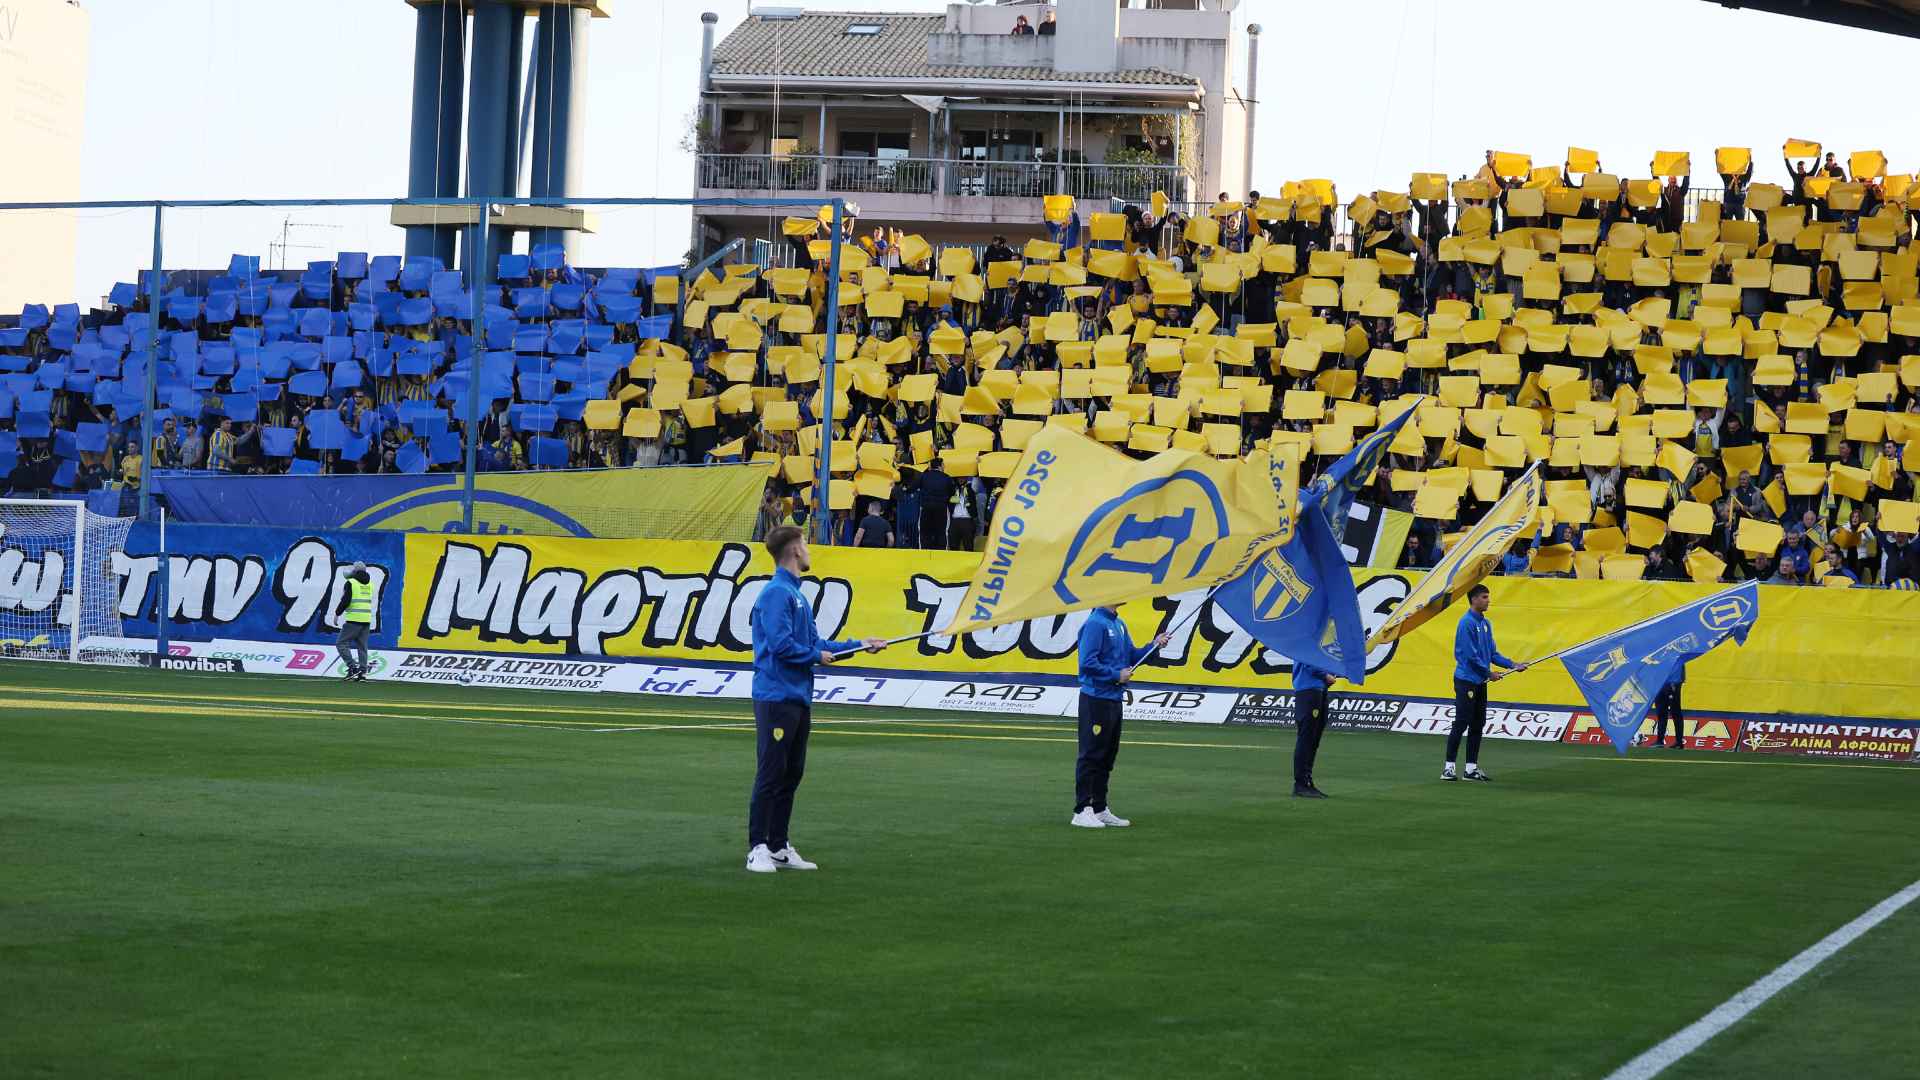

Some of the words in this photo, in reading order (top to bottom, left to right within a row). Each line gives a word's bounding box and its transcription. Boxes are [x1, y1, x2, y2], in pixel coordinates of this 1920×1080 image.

[211, 650, 285, 663] COSMOTE
[160, 657, 236, 673] novibet
[400, 654, 495, 672] ΕΝΩΣΗ
[493, 659, 616, 678] ΑΓΡΙΝΙΟΥ
[391, 669, 476, 683] ΑΓΡΟΤΙΚ
[477, 674, 603, 689] ΣΥΝΕΤΑΙΡΙΣΜΟΣ
[639, 677, 697, 694] taf
[812, 686, 846, 701] af
[944, 682, 1046, 701] A4B
[1238, 693, 1257, 707] K.
[1338, 713, 1394, 723] ΘΕΡΜΑΝΣΗ
[1747, 721, 1913, 739] ΚΤΗΝΙΑΤΡΙΚΑ
[1839, 738, 1911, 753] ΑΦΡΟΔΙΤΗ
